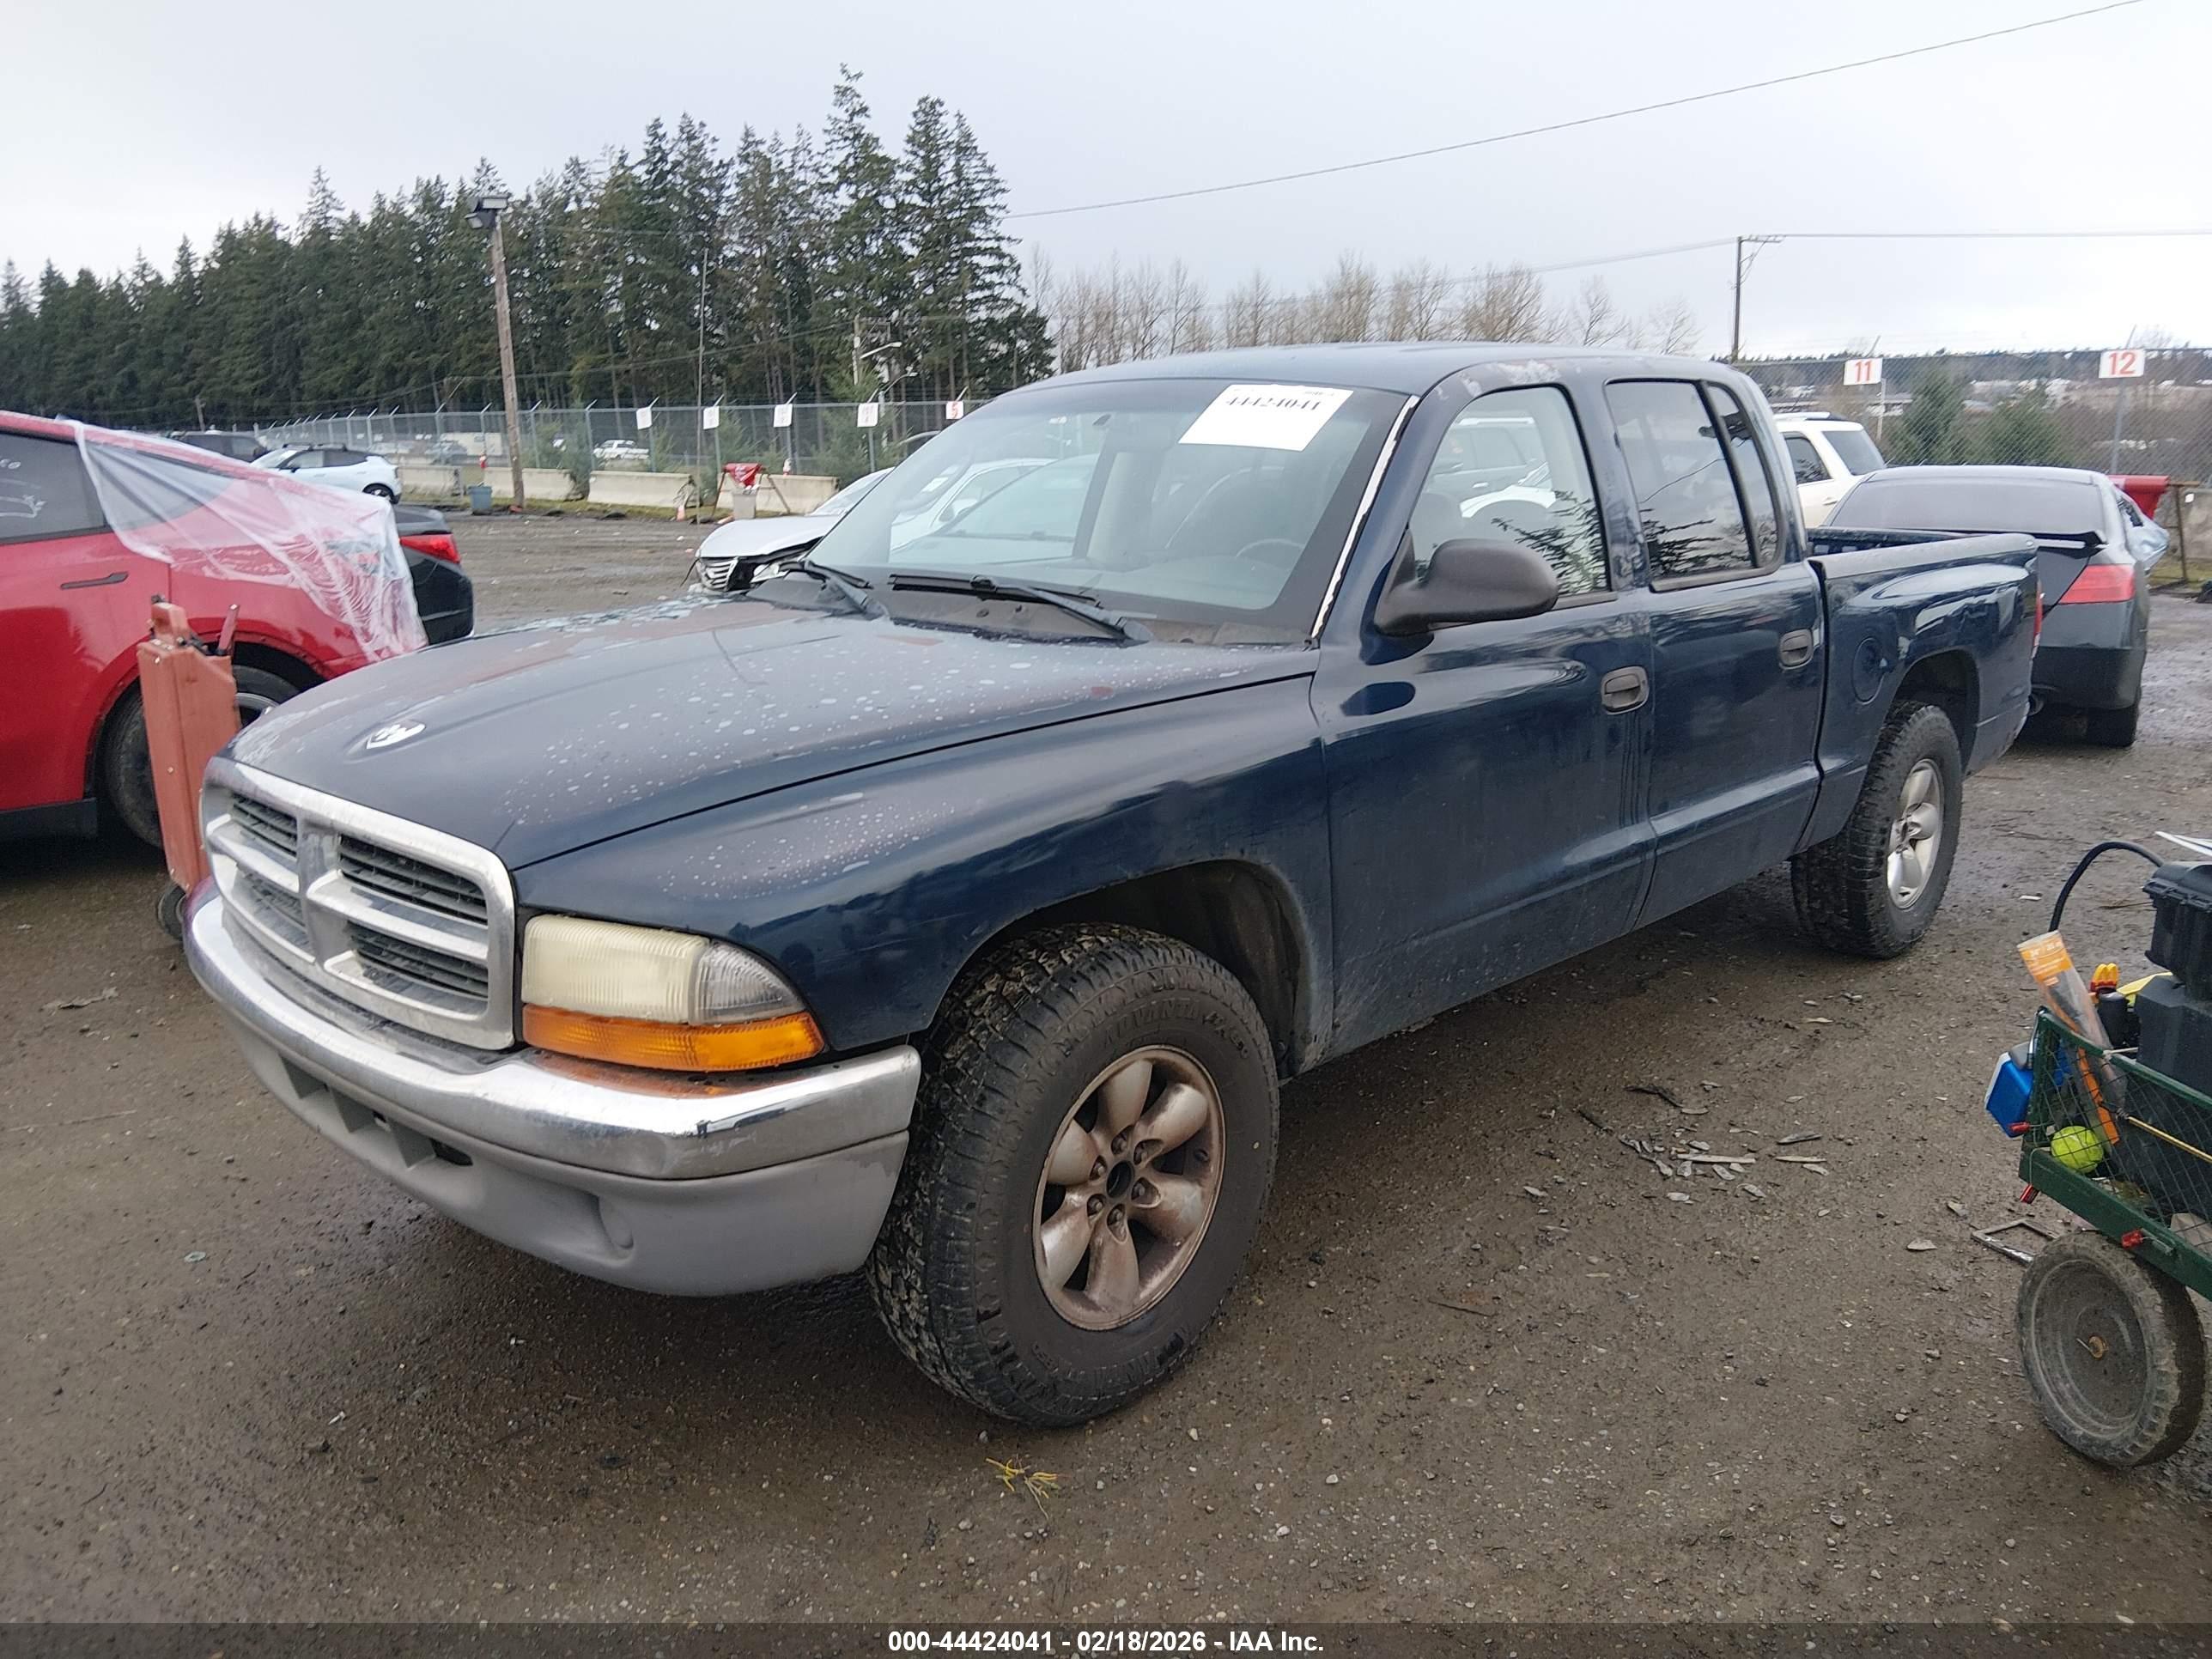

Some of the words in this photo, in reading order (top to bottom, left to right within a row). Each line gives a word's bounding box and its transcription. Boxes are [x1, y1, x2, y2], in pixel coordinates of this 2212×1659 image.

[1855, 361, 1872, 383] 11
[2109, 351, 2136, 375] 12
[1225, 396, 1322, 410] 44424041
